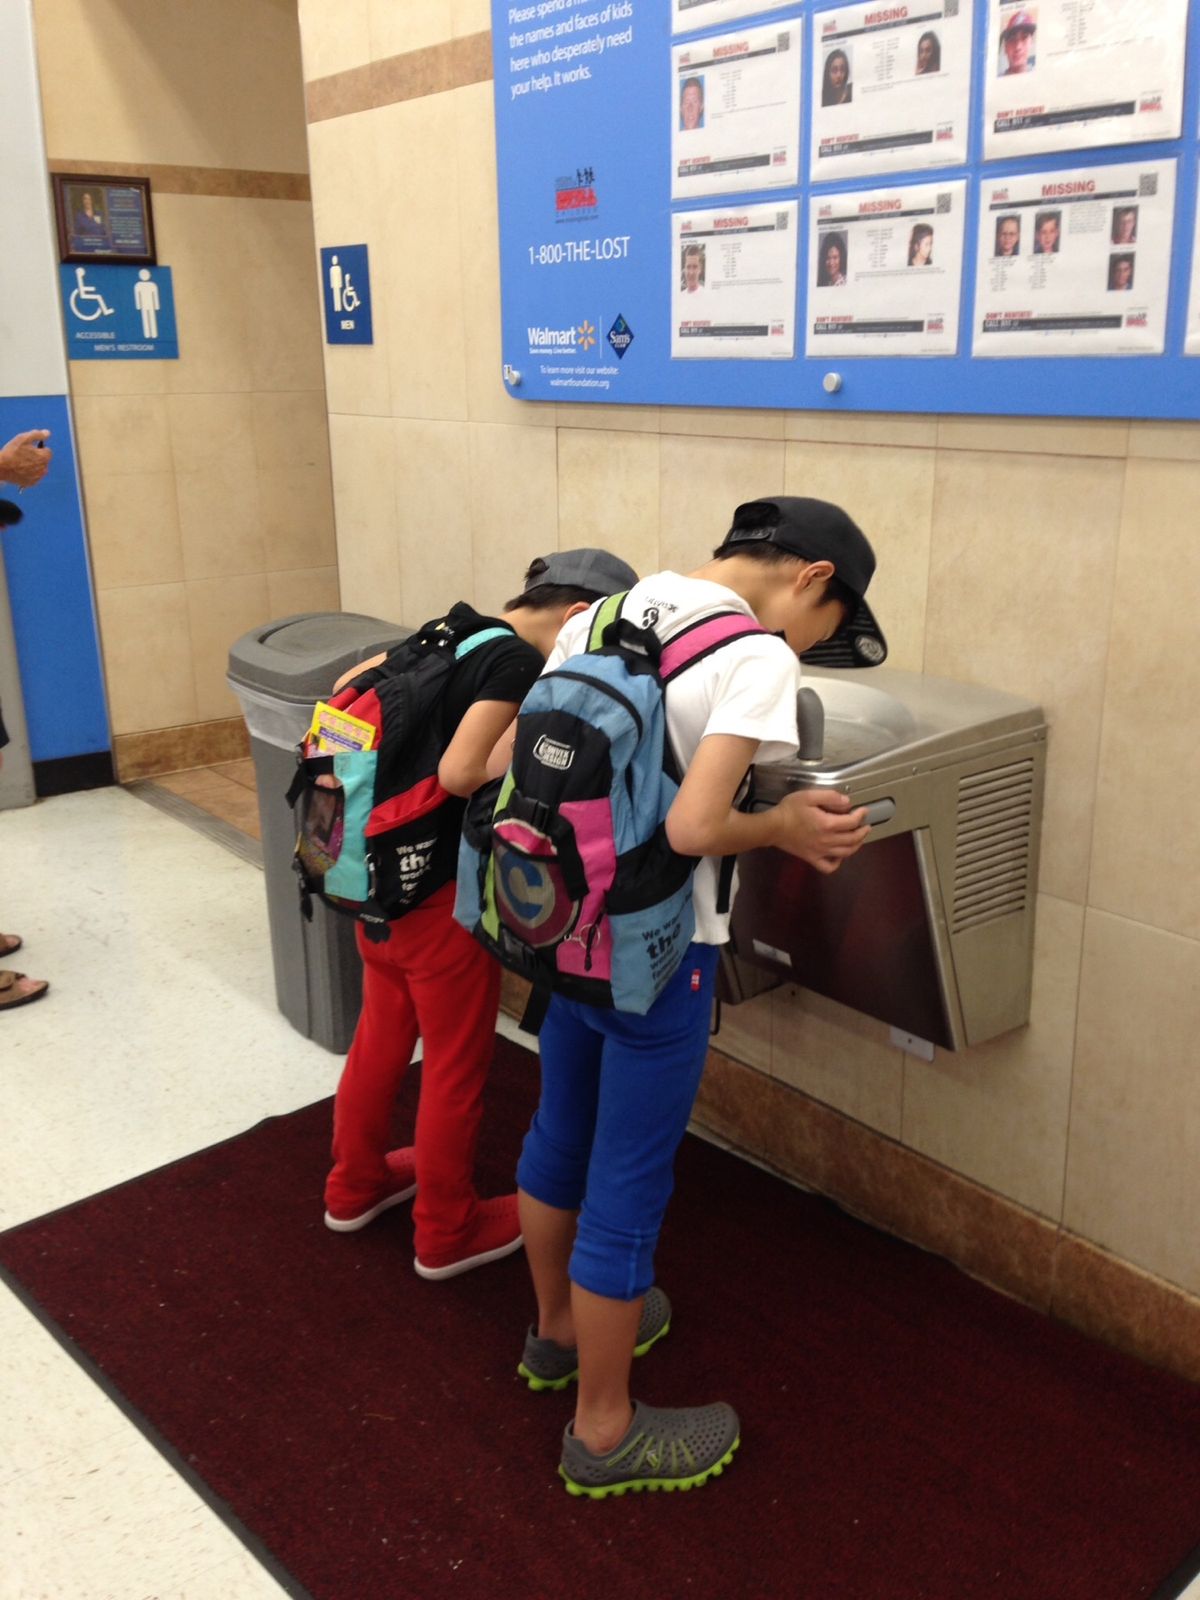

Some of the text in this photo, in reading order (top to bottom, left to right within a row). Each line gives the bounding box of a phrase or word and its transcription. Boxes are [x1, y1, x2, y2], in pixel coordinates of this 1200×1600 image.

[509, 6, 536, 24] Please
[537, 0, 565, 19] spend
[864, 6, 908, 25] MISSING
[509, 1, 633, 48] the names and faces of kids
[510, 25, 632, 72] here who desperately need
[510, 64, 592, 100] your help. It works.
[1042, 180, 1095, 196] MISSING
[859, 199, 902, 213] MISSING
[713, 216, 749, 229] MISSING
[529, 236, 630, 265] 1-800-THE-LOST
[528, 326, 576, 345] Walmart
[540, 365, 546, 374] To
[547, 365, 560, 374] learn
[575, 365, 585, 374] visit
[586, 367, 595, 375] our
[642, 928, 661, 941] We
